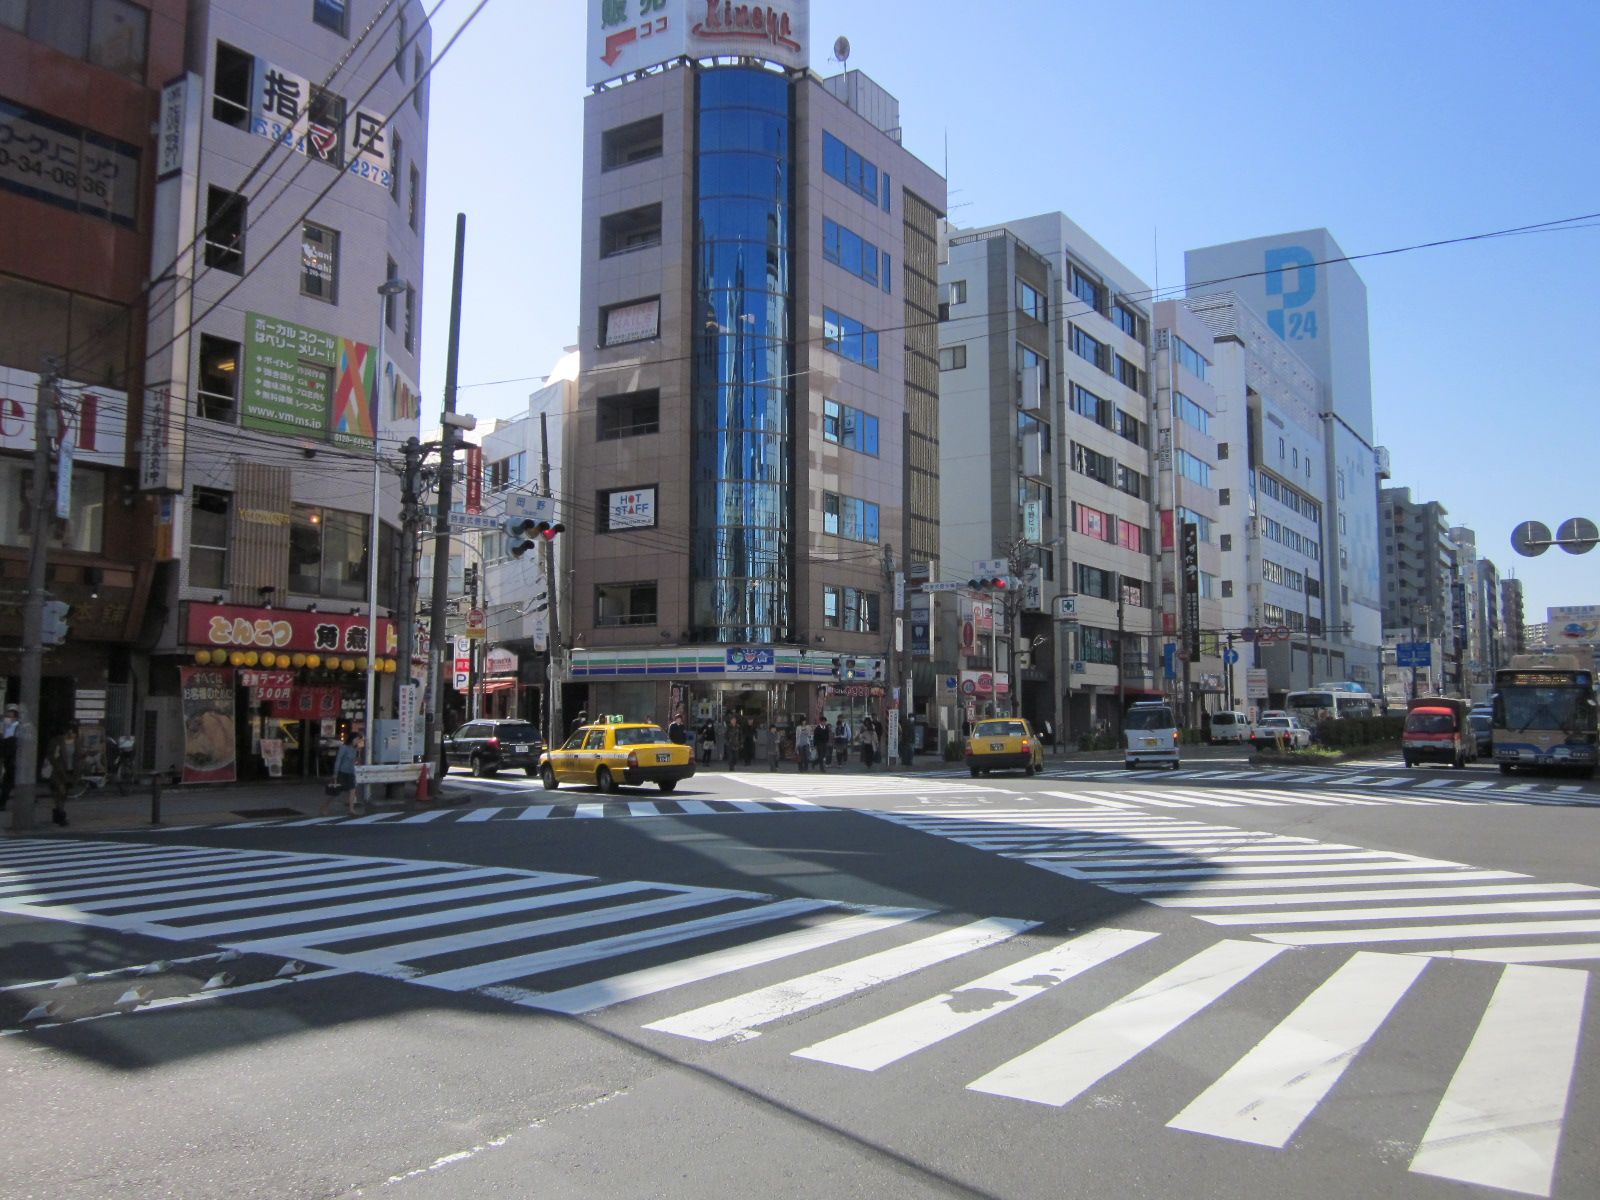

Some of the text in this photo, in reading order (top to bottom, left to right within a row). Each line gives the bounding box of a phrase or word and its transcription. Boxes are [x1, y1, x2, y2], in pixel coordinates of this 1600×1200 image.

[640, 16, 668, 38] ココ
[262, 69, 385, 159] 指 圧
[1289, 310, 1318, 340] 24
[299, 329, 335, 349] スクール
[615, 503, 649, 516] STAFF
[620, 493, 642, 505] HOT
[209, 616, 292, 647] とんこつ
[315, 623, 368, 651] 角煮
[456, 674, 466, 688] P
